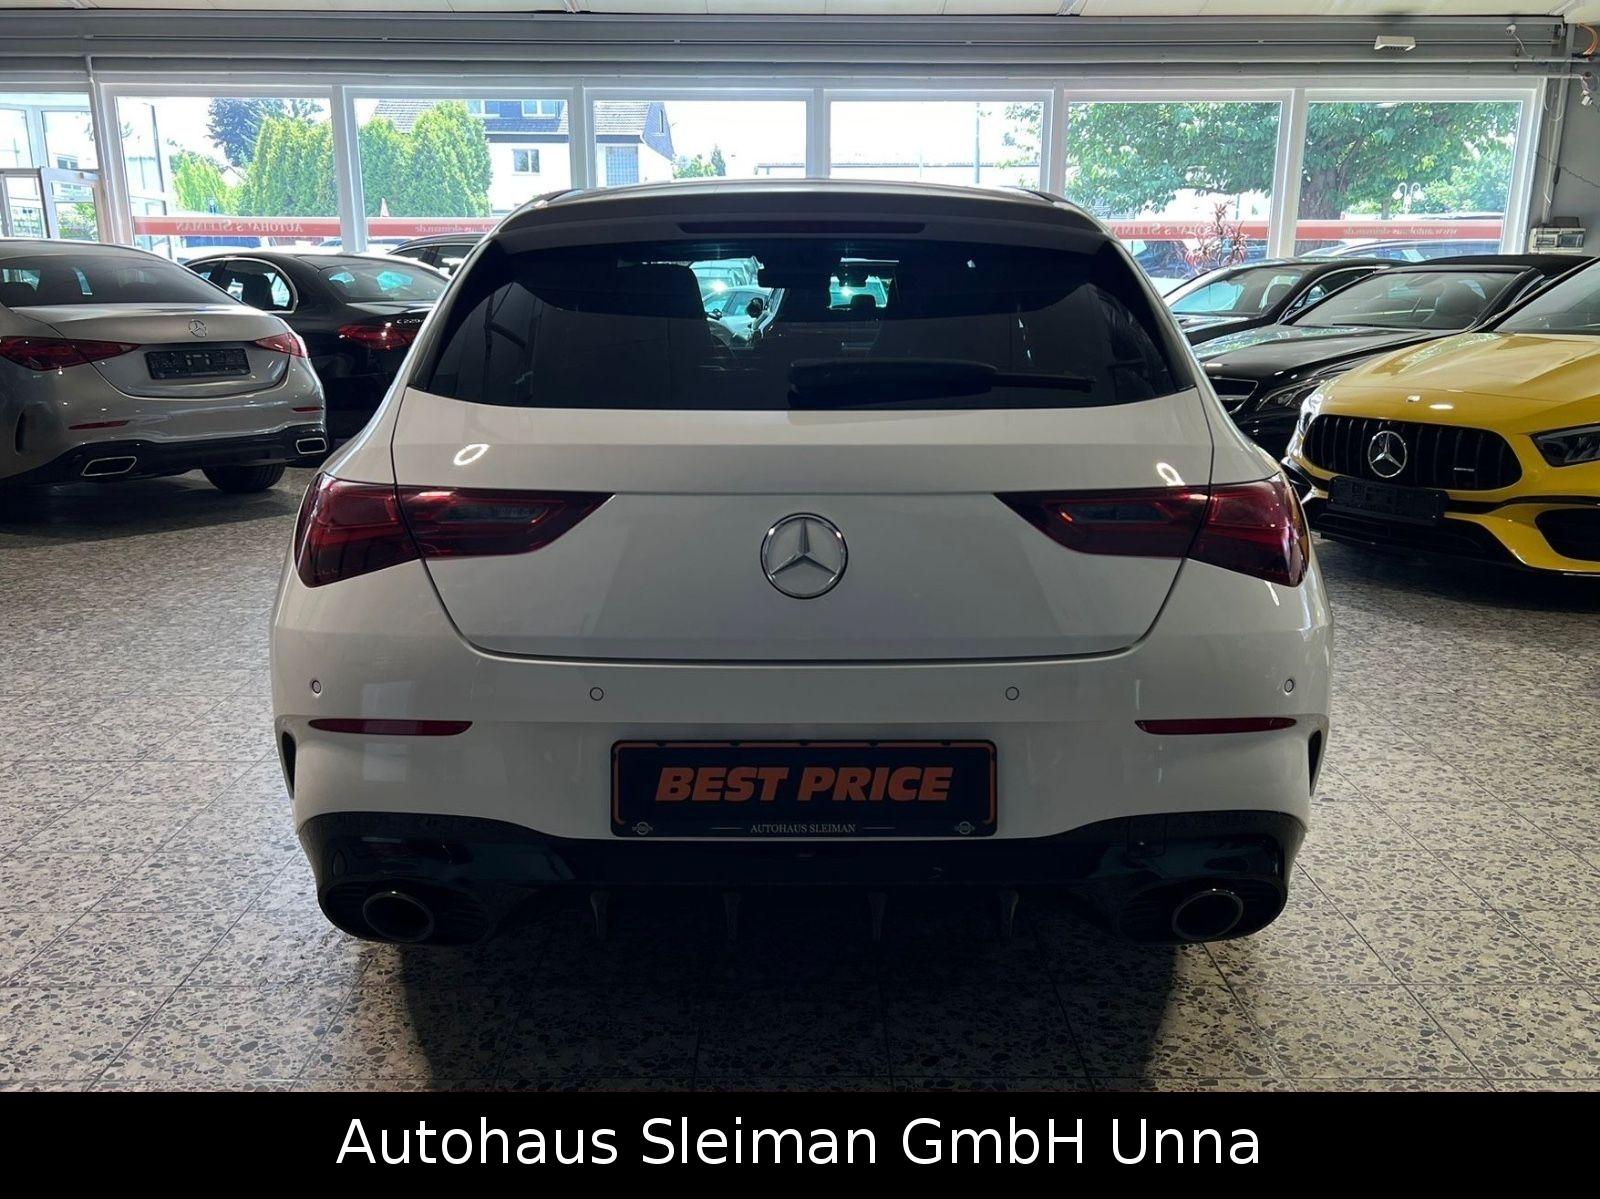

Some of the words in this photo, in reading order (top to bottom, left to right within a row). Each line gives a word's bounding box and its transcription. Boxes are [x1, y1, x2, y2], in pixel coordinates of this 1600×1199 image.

[655, 766, 790, 802] BEST
[797, 766, 954, 802] PRICE
[750, 822, 808, 834] AUTOHAUS
[809, 822, 857, 834] SLEIMAN
